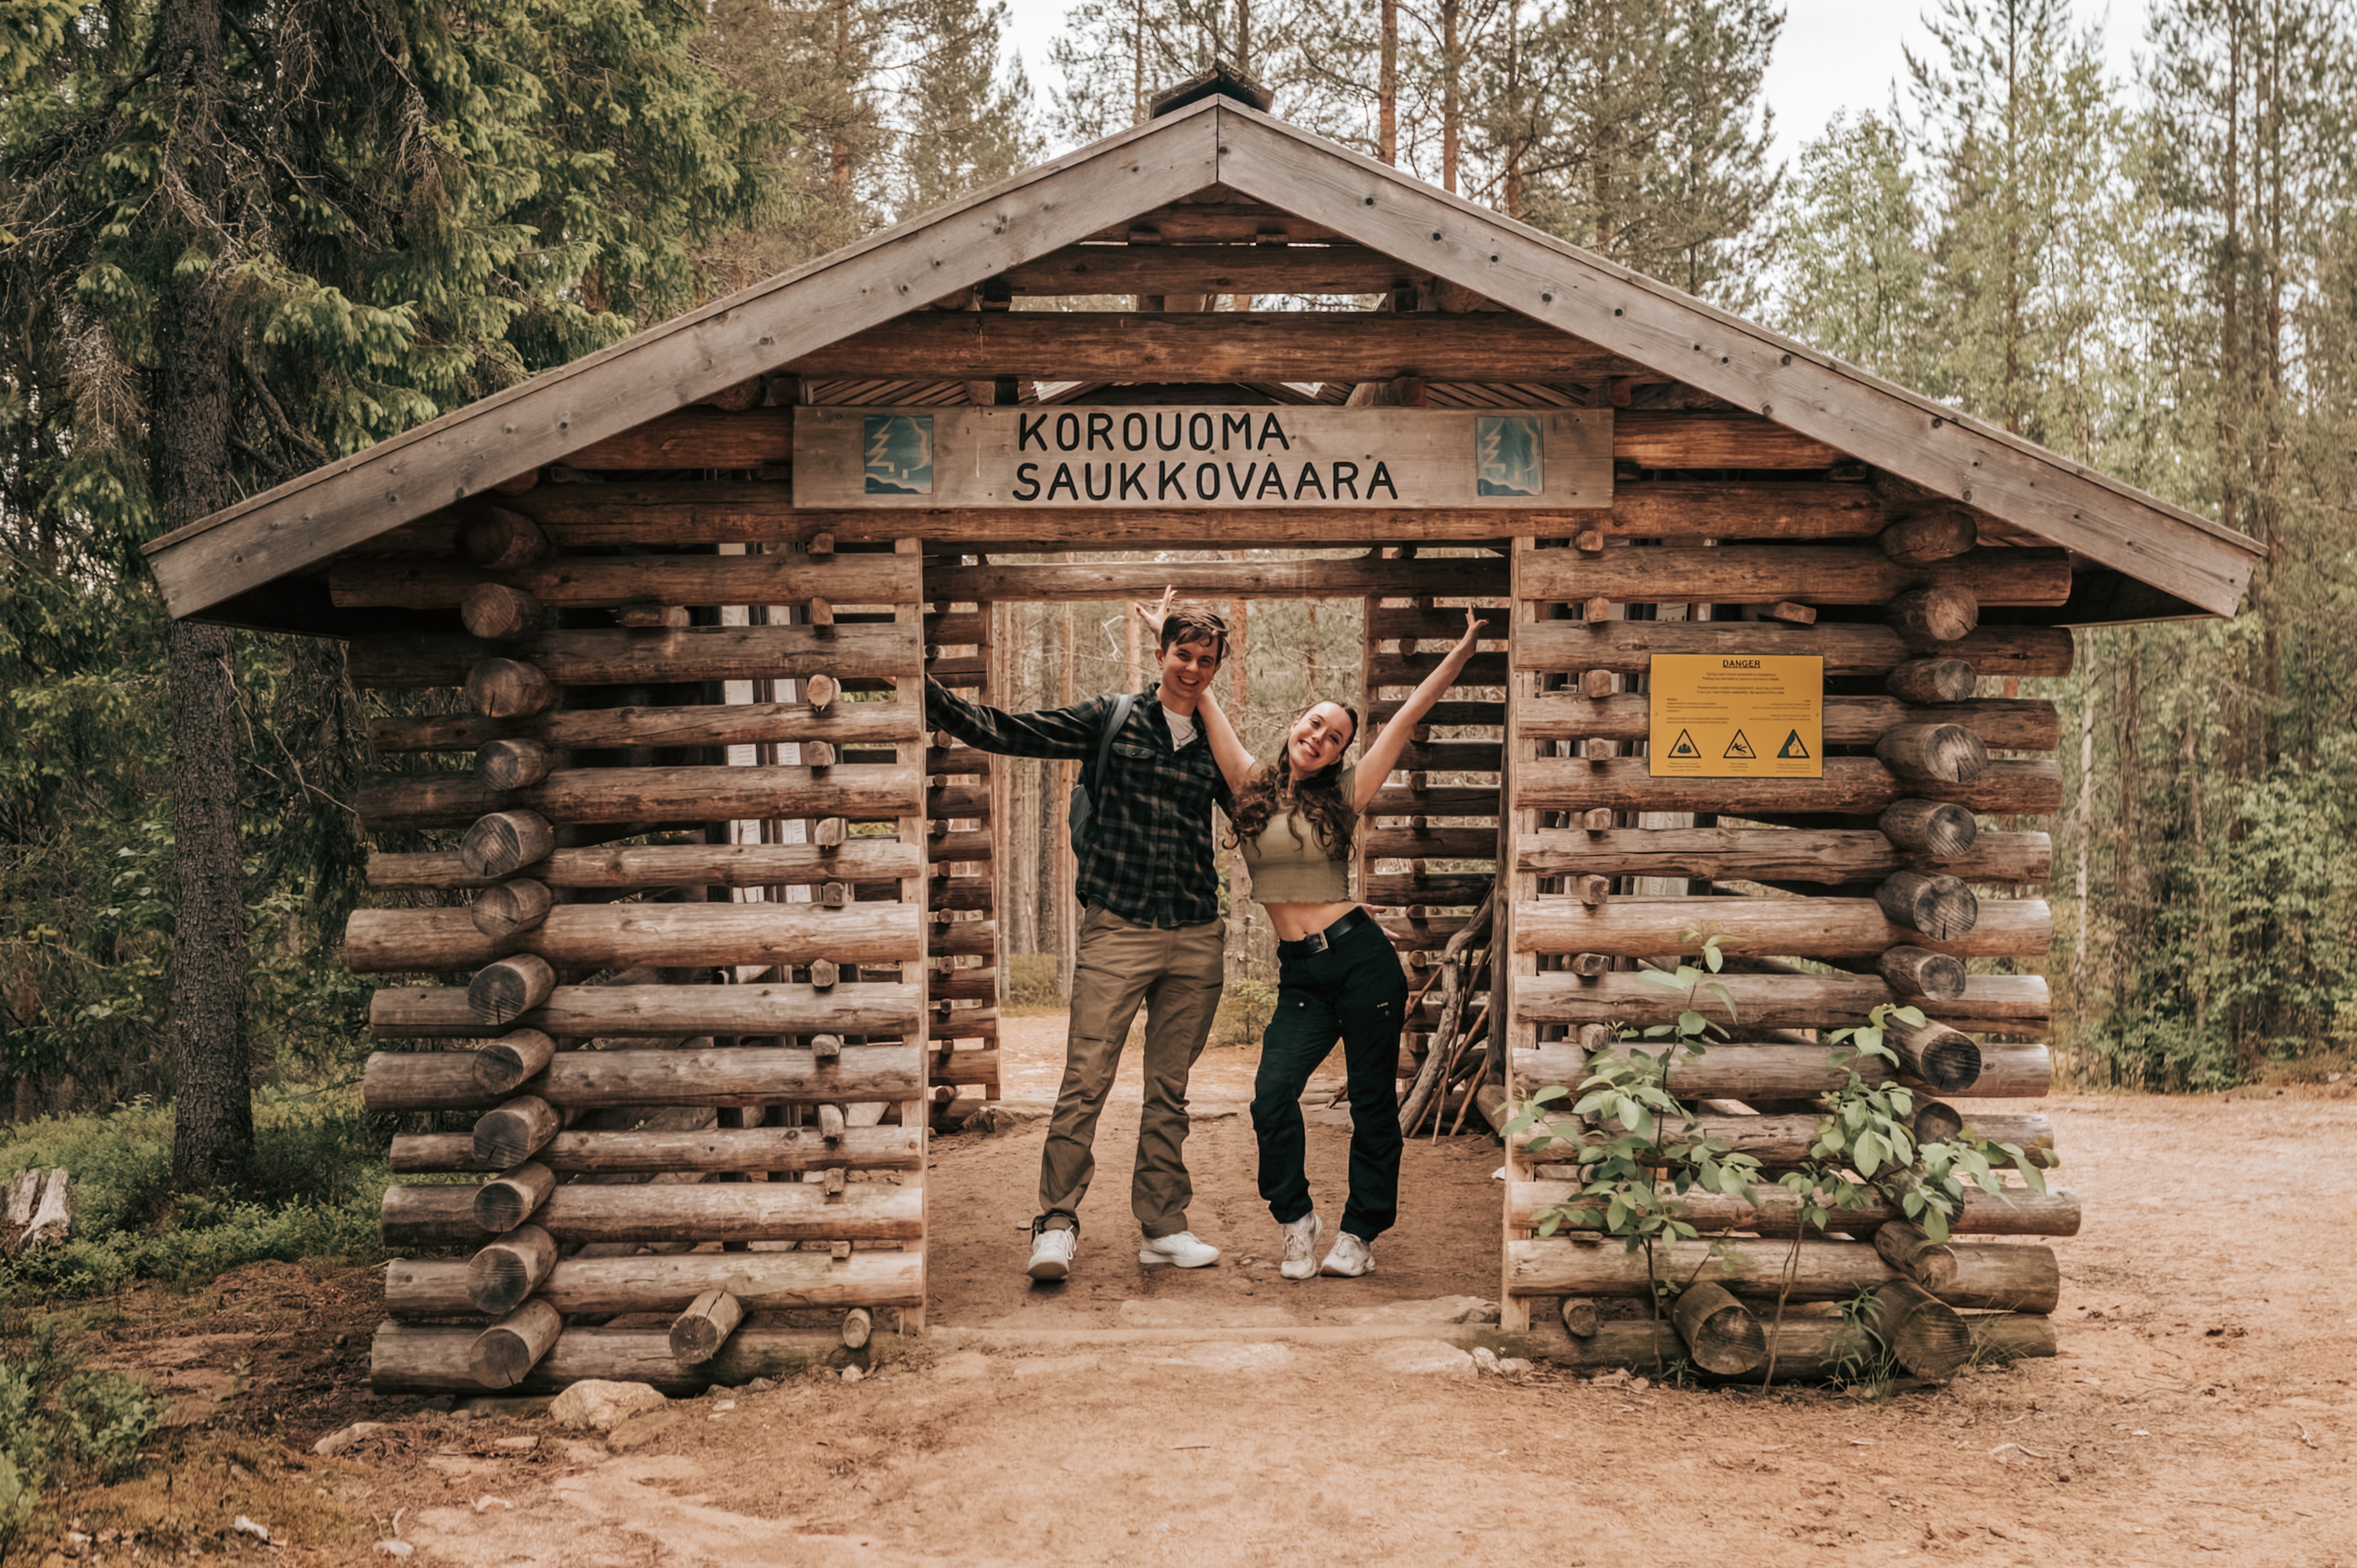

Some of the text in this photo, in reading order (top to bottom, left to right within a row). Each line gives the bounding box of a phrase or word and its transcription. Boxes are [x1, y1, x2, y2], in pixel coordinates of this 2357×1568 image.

[1019, 412, 1290, 451] KOROUOMA
[1013, 460, 1398, 501] SAUKKOVAARA
[1723, 660, 1760, 668] DANGER
